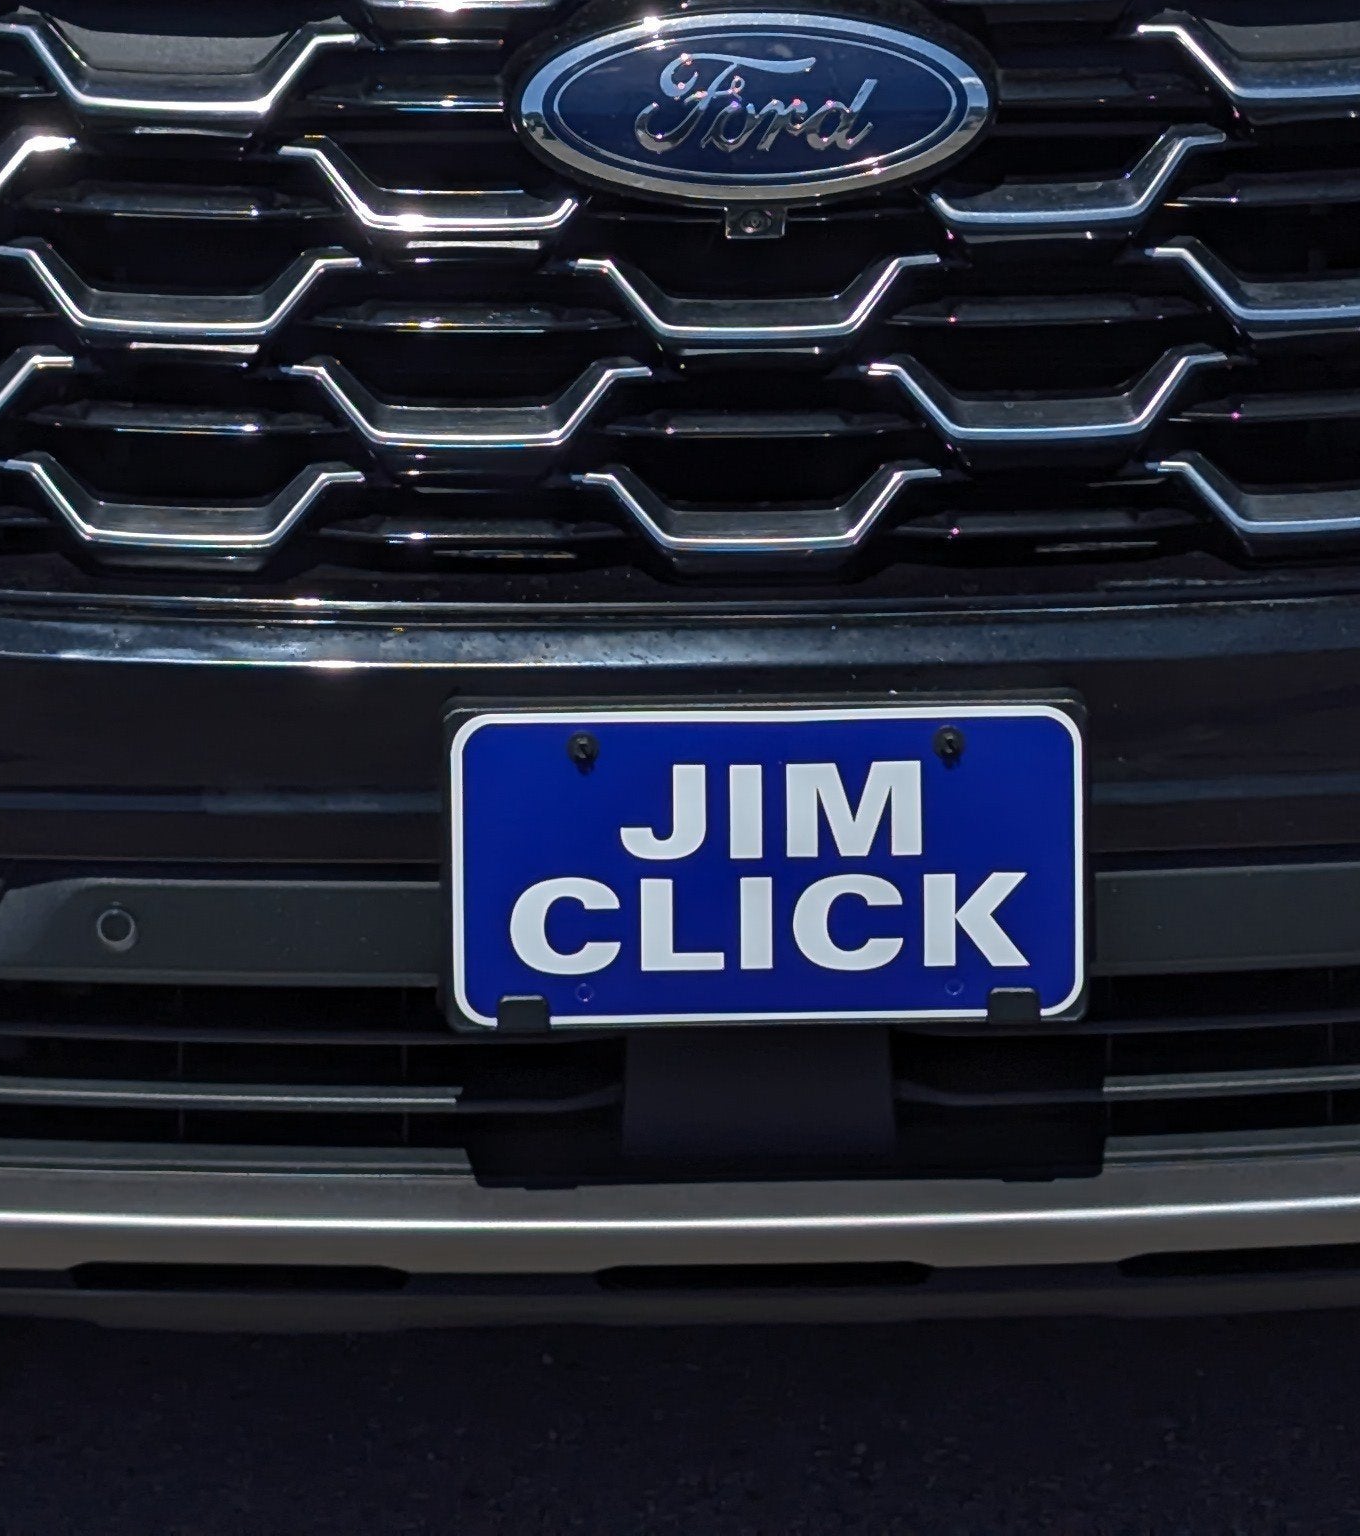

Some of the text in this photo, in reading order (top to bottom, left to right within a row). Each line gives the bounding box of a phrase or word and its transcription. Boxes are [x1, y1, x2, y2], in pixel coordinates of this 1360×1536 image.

[635, 52, 878, 154] Ford
[620, 760, 922, 860] JIM
[509, 872, 1030, 975] CLICK
